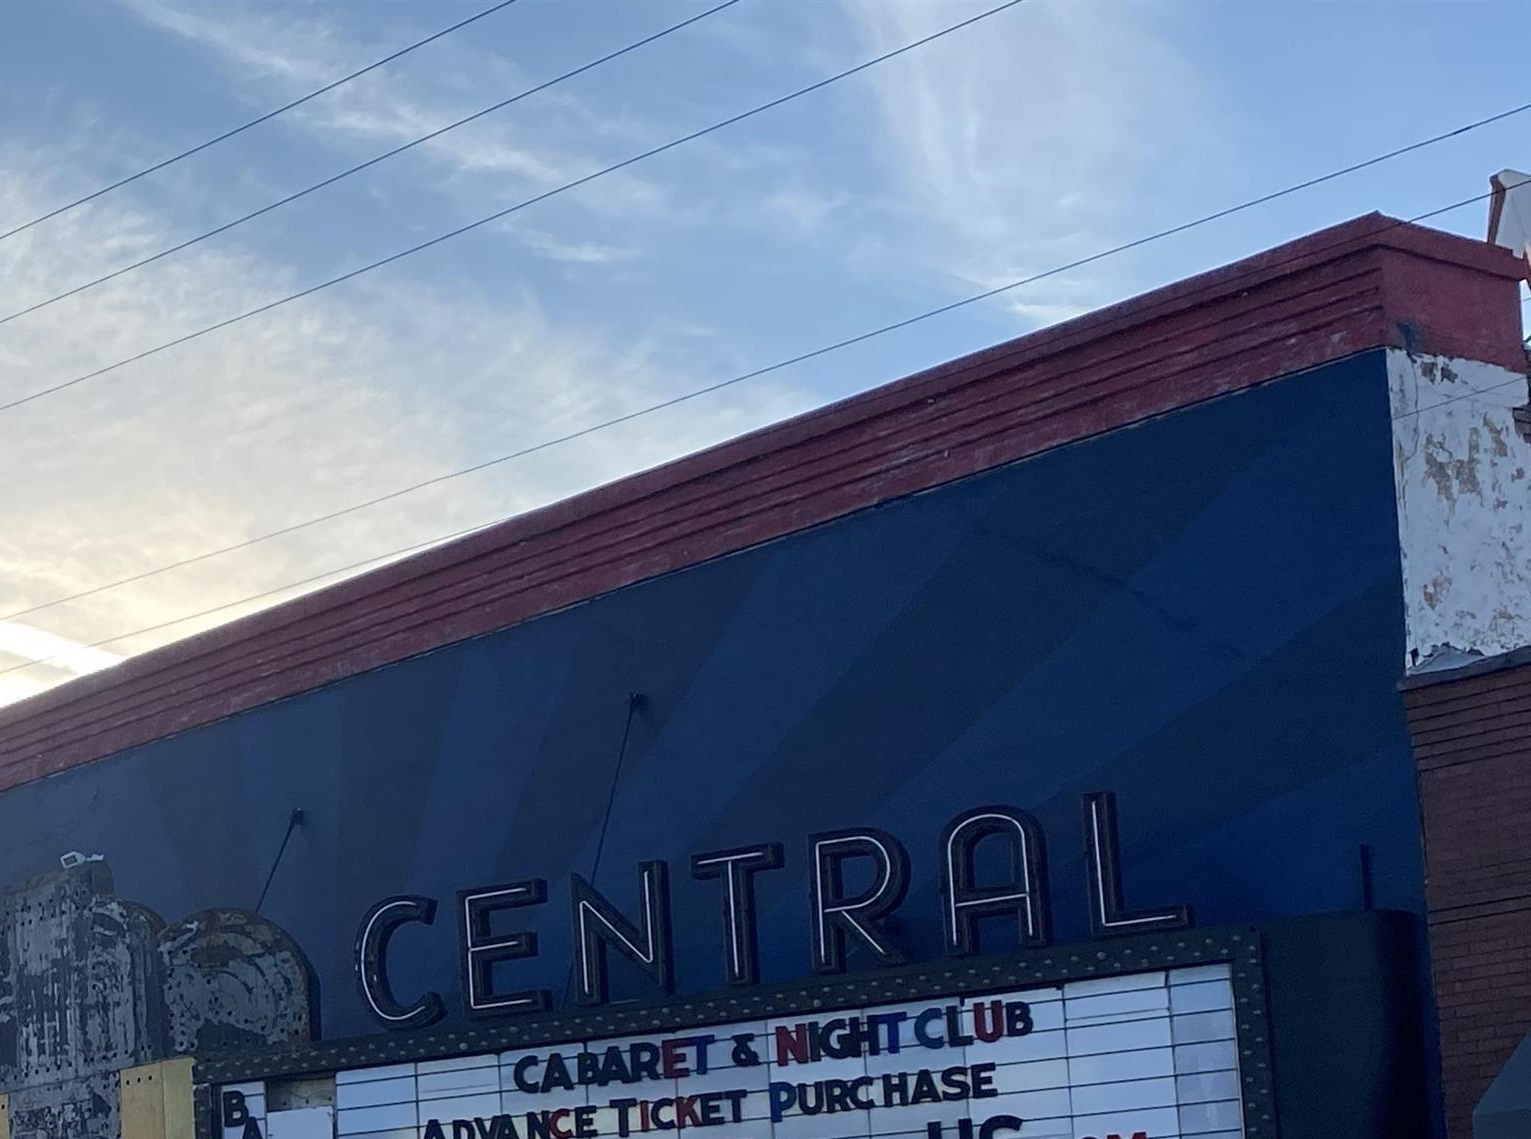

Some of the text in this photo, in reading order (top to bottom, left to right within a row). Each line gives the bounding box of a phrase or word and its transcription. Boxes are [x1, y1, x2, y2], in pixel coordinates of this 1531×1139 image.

[354, 791, 1191, 1030] CENTRAL
[514, 1034, 715, 1093] CABARET
[731, 1034, 759, 1066] &
[610, 1089, 747, 1137] TICKET
[769, 1062, 998, 1122] PURCHASE
